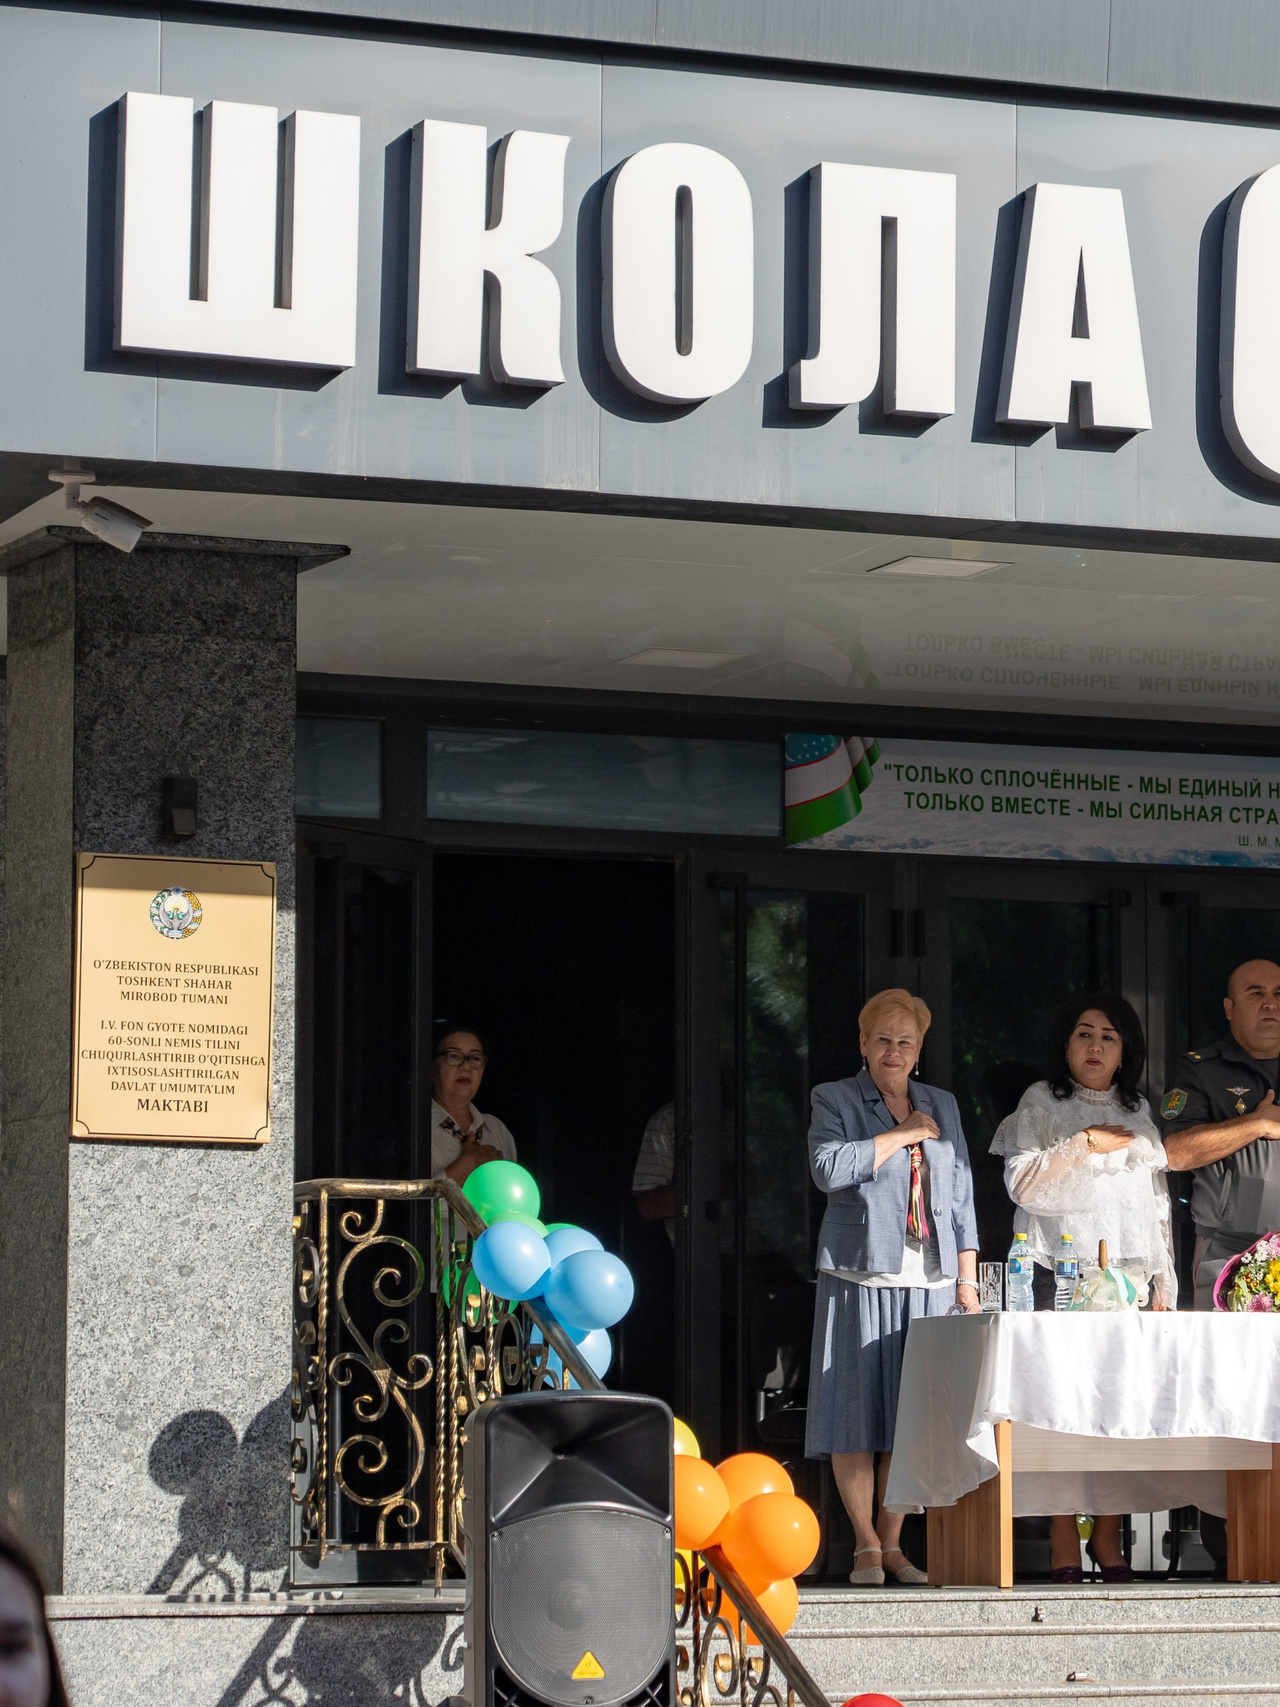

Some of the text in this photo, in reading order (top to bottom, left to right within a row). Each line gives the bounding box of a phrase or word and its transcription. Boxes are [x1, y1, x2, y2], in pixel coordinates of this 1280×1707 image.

[117, 92, 1152, 438] ШКОЛА
[884, 763, 974, 785] "ТОЛЬКО
[980, 768, 1120, 792] СПЛОЧЁННЫЕ
[1139, 776, 1171, 795] МЫ
[1178, 777, 1262, 799] ЕДИНЫЙ
[903, 791, 984, 812] ТОЛЬКО
[991, 795, 1071, 816] ВМЕСТЕ
[1090, 800, 1123, 819] МЫ
[1129, 801, 1223, 824] СИЛЬНАЯ
[1238, 834, 1253, 848] Ш.
[1257, 835, 1271, 848] М.
[174, 962, 259, 976] RESPUBLIKASI
[117, 975, 233, 990] TOSHKENT SHAHAR
[120, 990, 228, 1005] MIROBOD TUMANI
[100, 1020, 249, 1036] I.V. FON GYOTE NOMIDAGI
[107, 1035, 241, 1050] 60-SONLI NEMIS TILINI
[81, 1049, 195, 1064] CHUQURLASHTIRIB
[107, 1065, 240, 1080] IXTISOSLASHTIRILGAN
[110, 1081, 157, 1092] DAVLAT
[136, 1098, 209, 1113] MAKTABI
